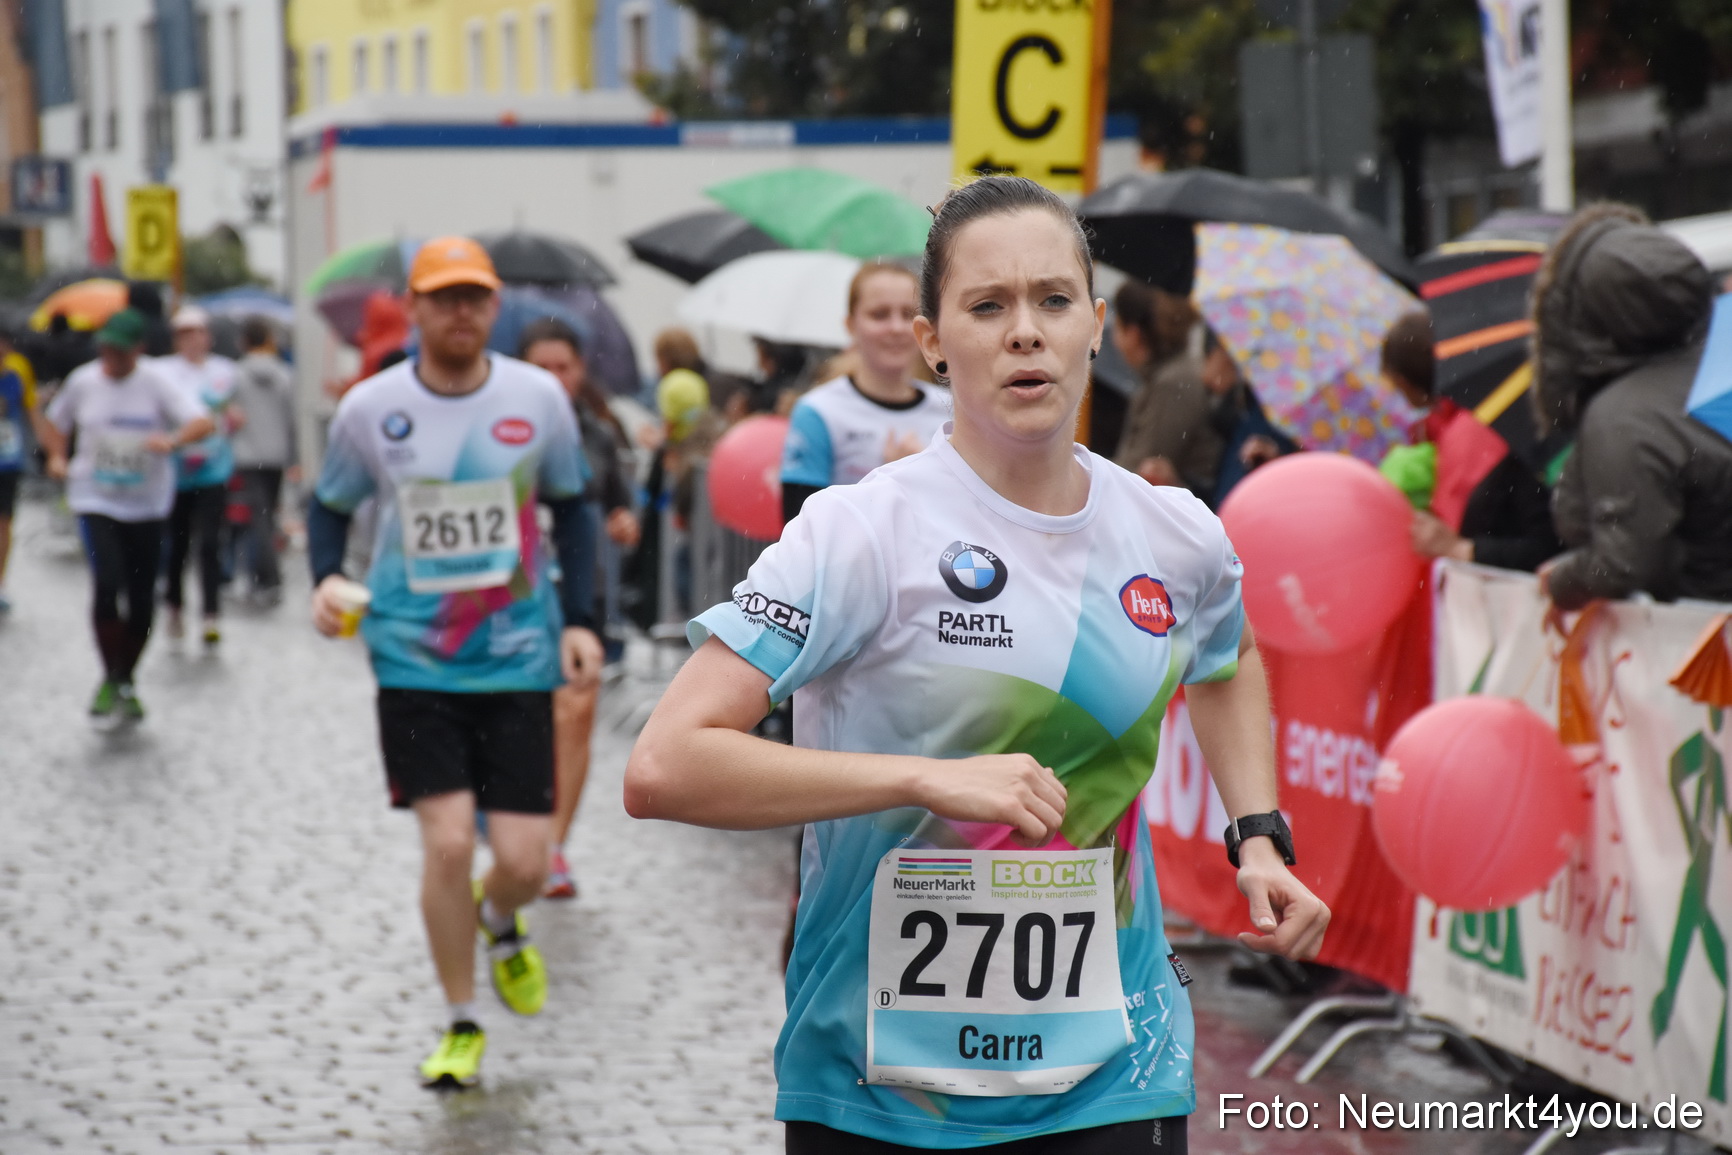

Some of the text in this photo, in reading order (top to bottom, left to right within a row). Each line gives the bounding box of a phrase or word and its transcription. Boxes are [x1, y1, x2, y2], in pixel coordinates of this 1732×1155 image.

[995, 34, 1063, 141] C
[137, 213, 165, 257] D
[414, 505, 507, 552] 2612
[942, 542, 998, 564] BMW
[938, 611, 1013, 633] PARTL
[938, 630, 1013, 649] Neumarkt
[893, 877, 976, 892] NeuerMarkt
[992, 859, 1098, 888] BOCK
[946, 894, 972, 902] genießen
[991, 889, 1098, 900] inspired by smart concepts
[899, 910, 1096, 1001] 2707
[958, 1025, 1044, 1061] Carra
